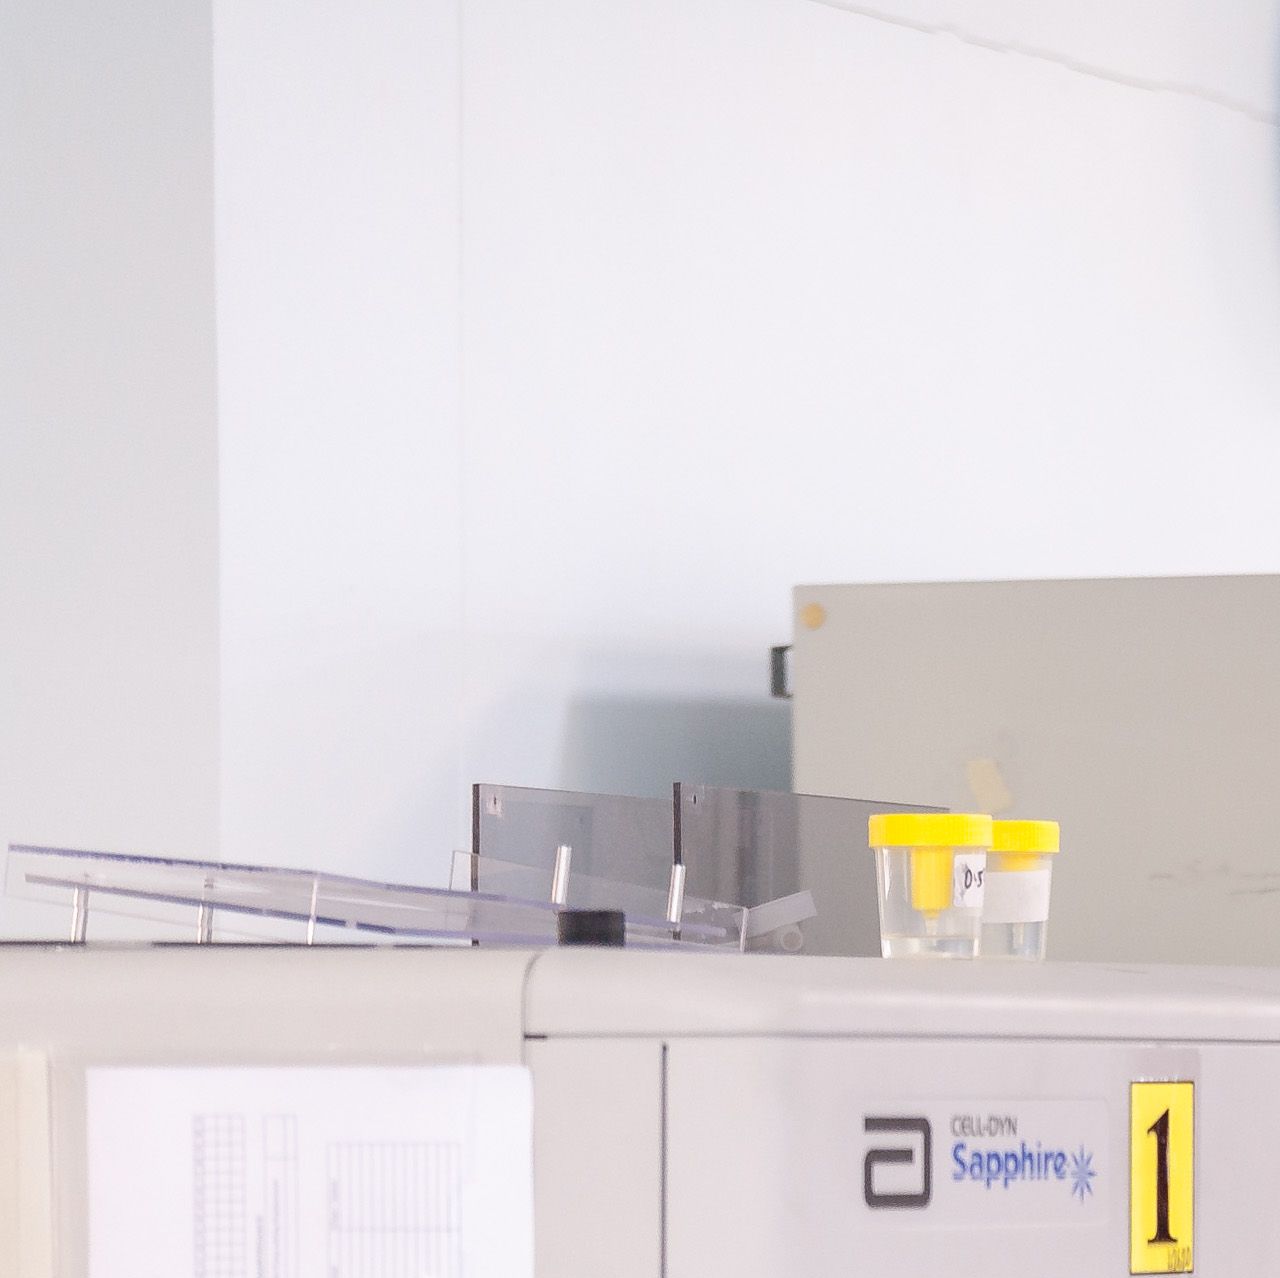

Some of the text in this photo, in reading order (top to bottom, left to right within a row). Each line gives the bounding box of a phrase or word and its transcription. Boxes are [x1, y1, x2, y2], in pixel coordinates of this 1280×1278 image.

[951, 1115, 1017, 1136] CELL-DYN
[952, 1141, 1067, 1189] Sapphire
[1147, 1108, 1178, 1245] 1
